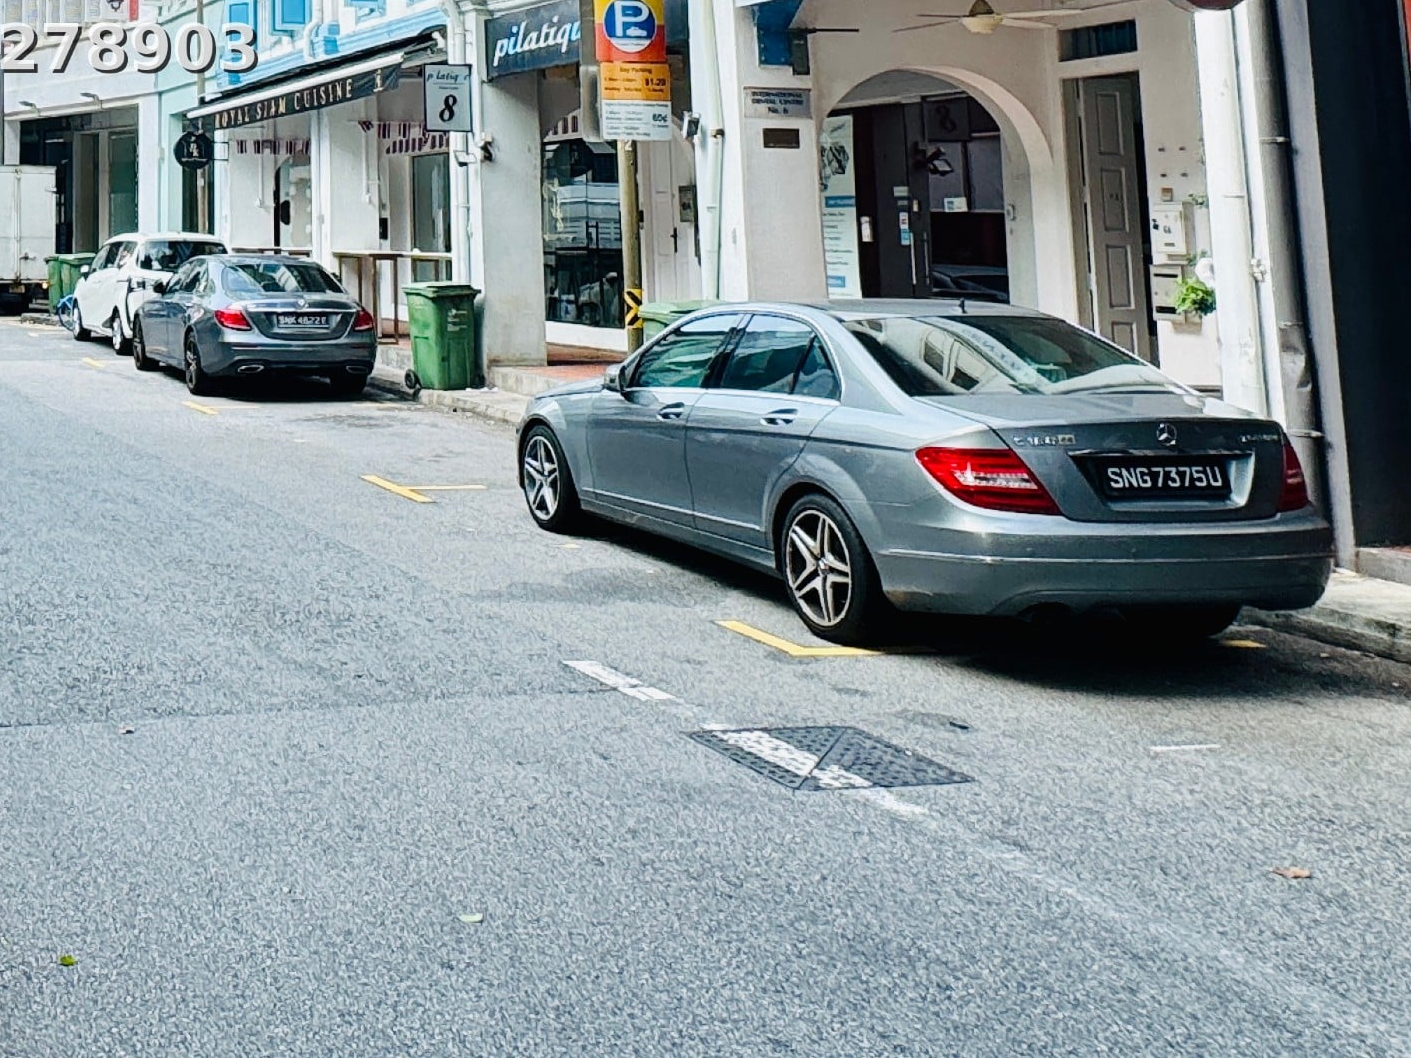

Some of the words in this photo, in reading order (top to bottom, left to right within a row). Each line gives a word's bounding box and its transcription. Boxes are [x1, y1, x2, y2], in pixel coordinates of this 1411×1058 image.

[613, 0, 650, 38] P
[493, 15, 581, 67] pilatiqu
[214, 110, 250, 129] ROYAL
[256, 96, 287, 120] SIAM
[294, 78, 353, 110] CUISINE
[439, 94, 458, 122] 8
[1107, 466, 1223, 489] SNG7375U
